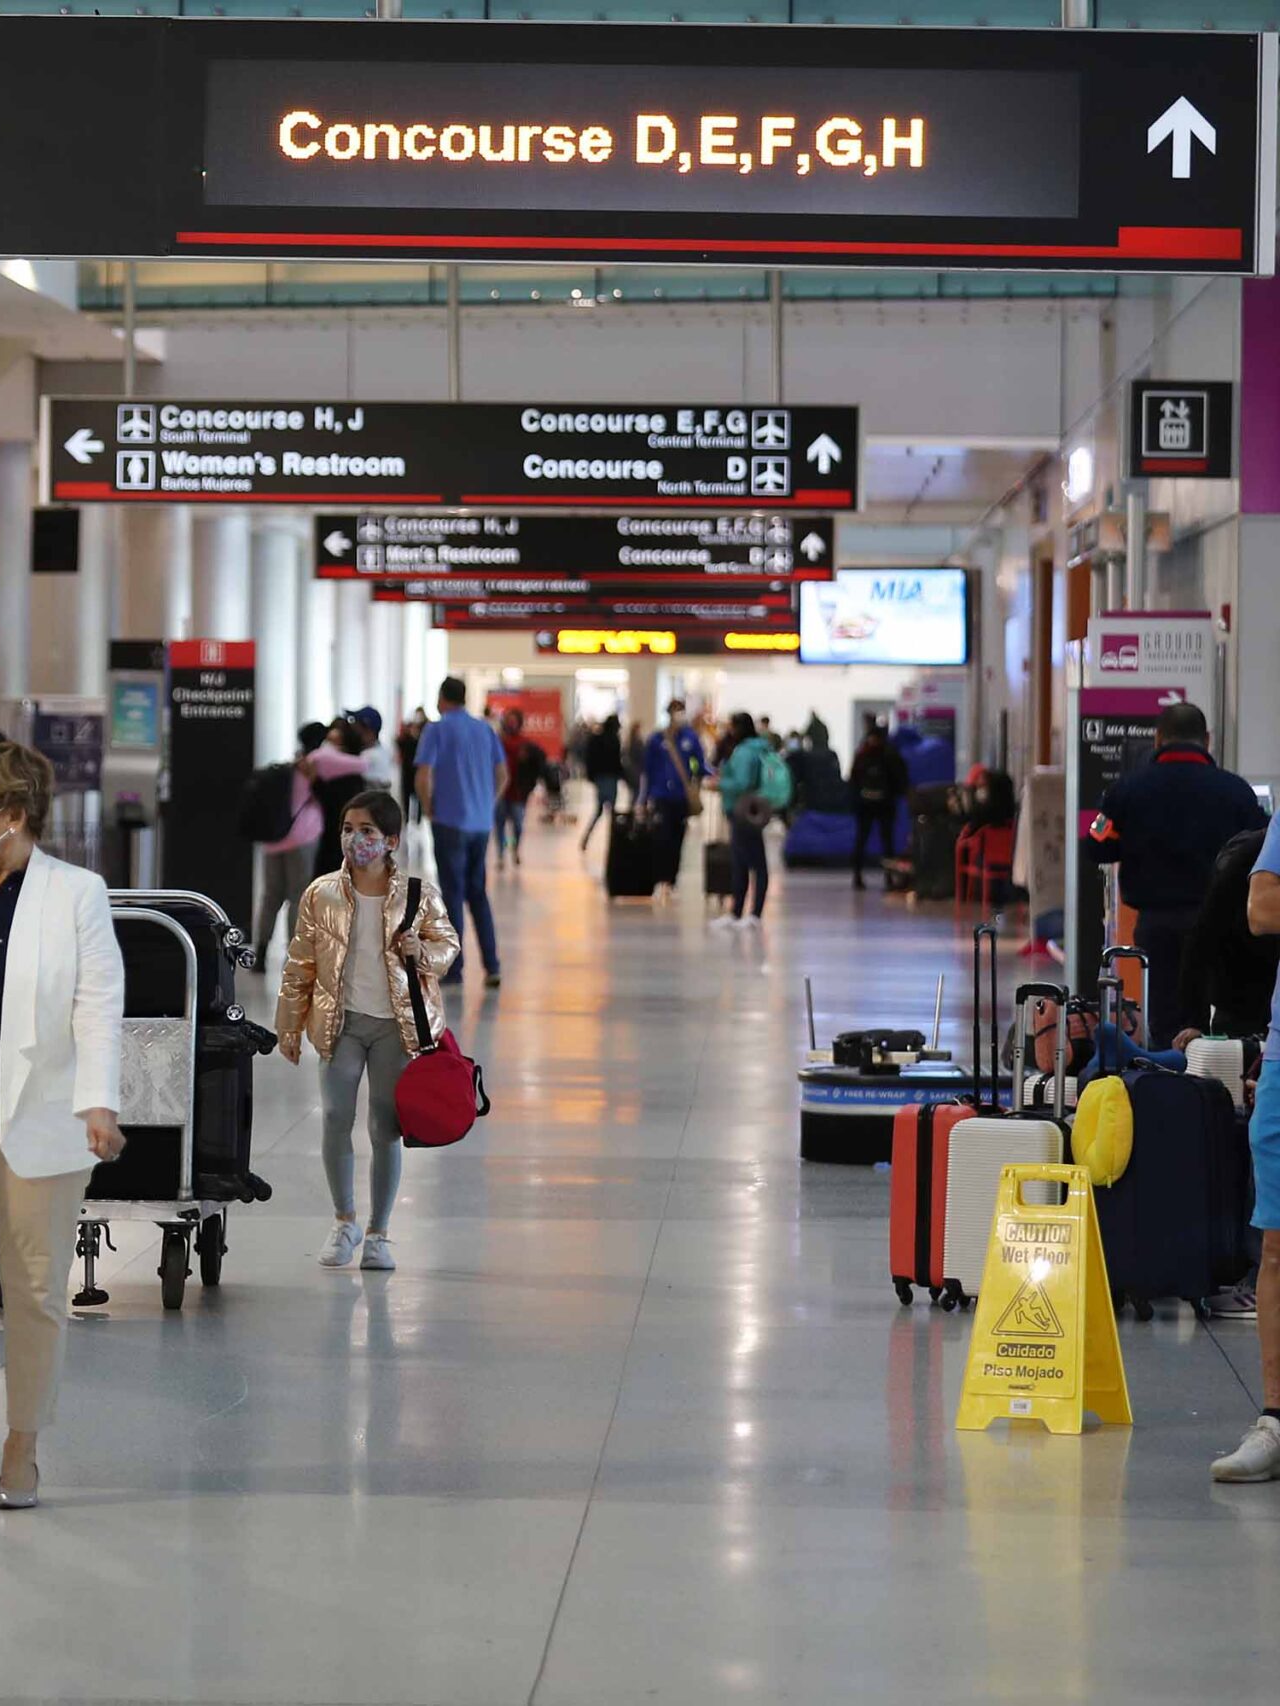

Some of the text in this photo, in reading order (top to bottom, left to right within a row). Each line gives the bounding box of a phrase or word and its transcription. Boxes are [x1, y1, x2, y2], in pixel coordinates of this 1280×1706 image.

[277, 110, 924, 177] Concourse D,E,F,G,H
[160, 405, 365, 434] Concourse H, J
[520, 408, 667, 433] Concourse
[160, 431, 251, 444] South Terminal
[647, 433, 747, 449] Central Terminal
[161, 451, 406, 477] Women's Restroom
[522, 454, 748, 480] Concourse D
[657, 480, 747, 496] North Terminal
[617, 516, 713, 536] Concourse
[618, 545, 712, 565] Concourse
[870, 579, 923, 601] MIA
[1143, 632, 1202, 649] GROUND
[172, 687, 253, 704] Checkpoint
[181, 703, 245, 719] Entrance
[1105, 725, 1124, 736] MIA
[1006, 1223, 1071, 1243] CAUTION
[1001, 1246, 1029, 1264] Wet
[998, 1343, 1055, 1360] Cuidado
[983, 1363, 1064, 1381] Piso Mojado
